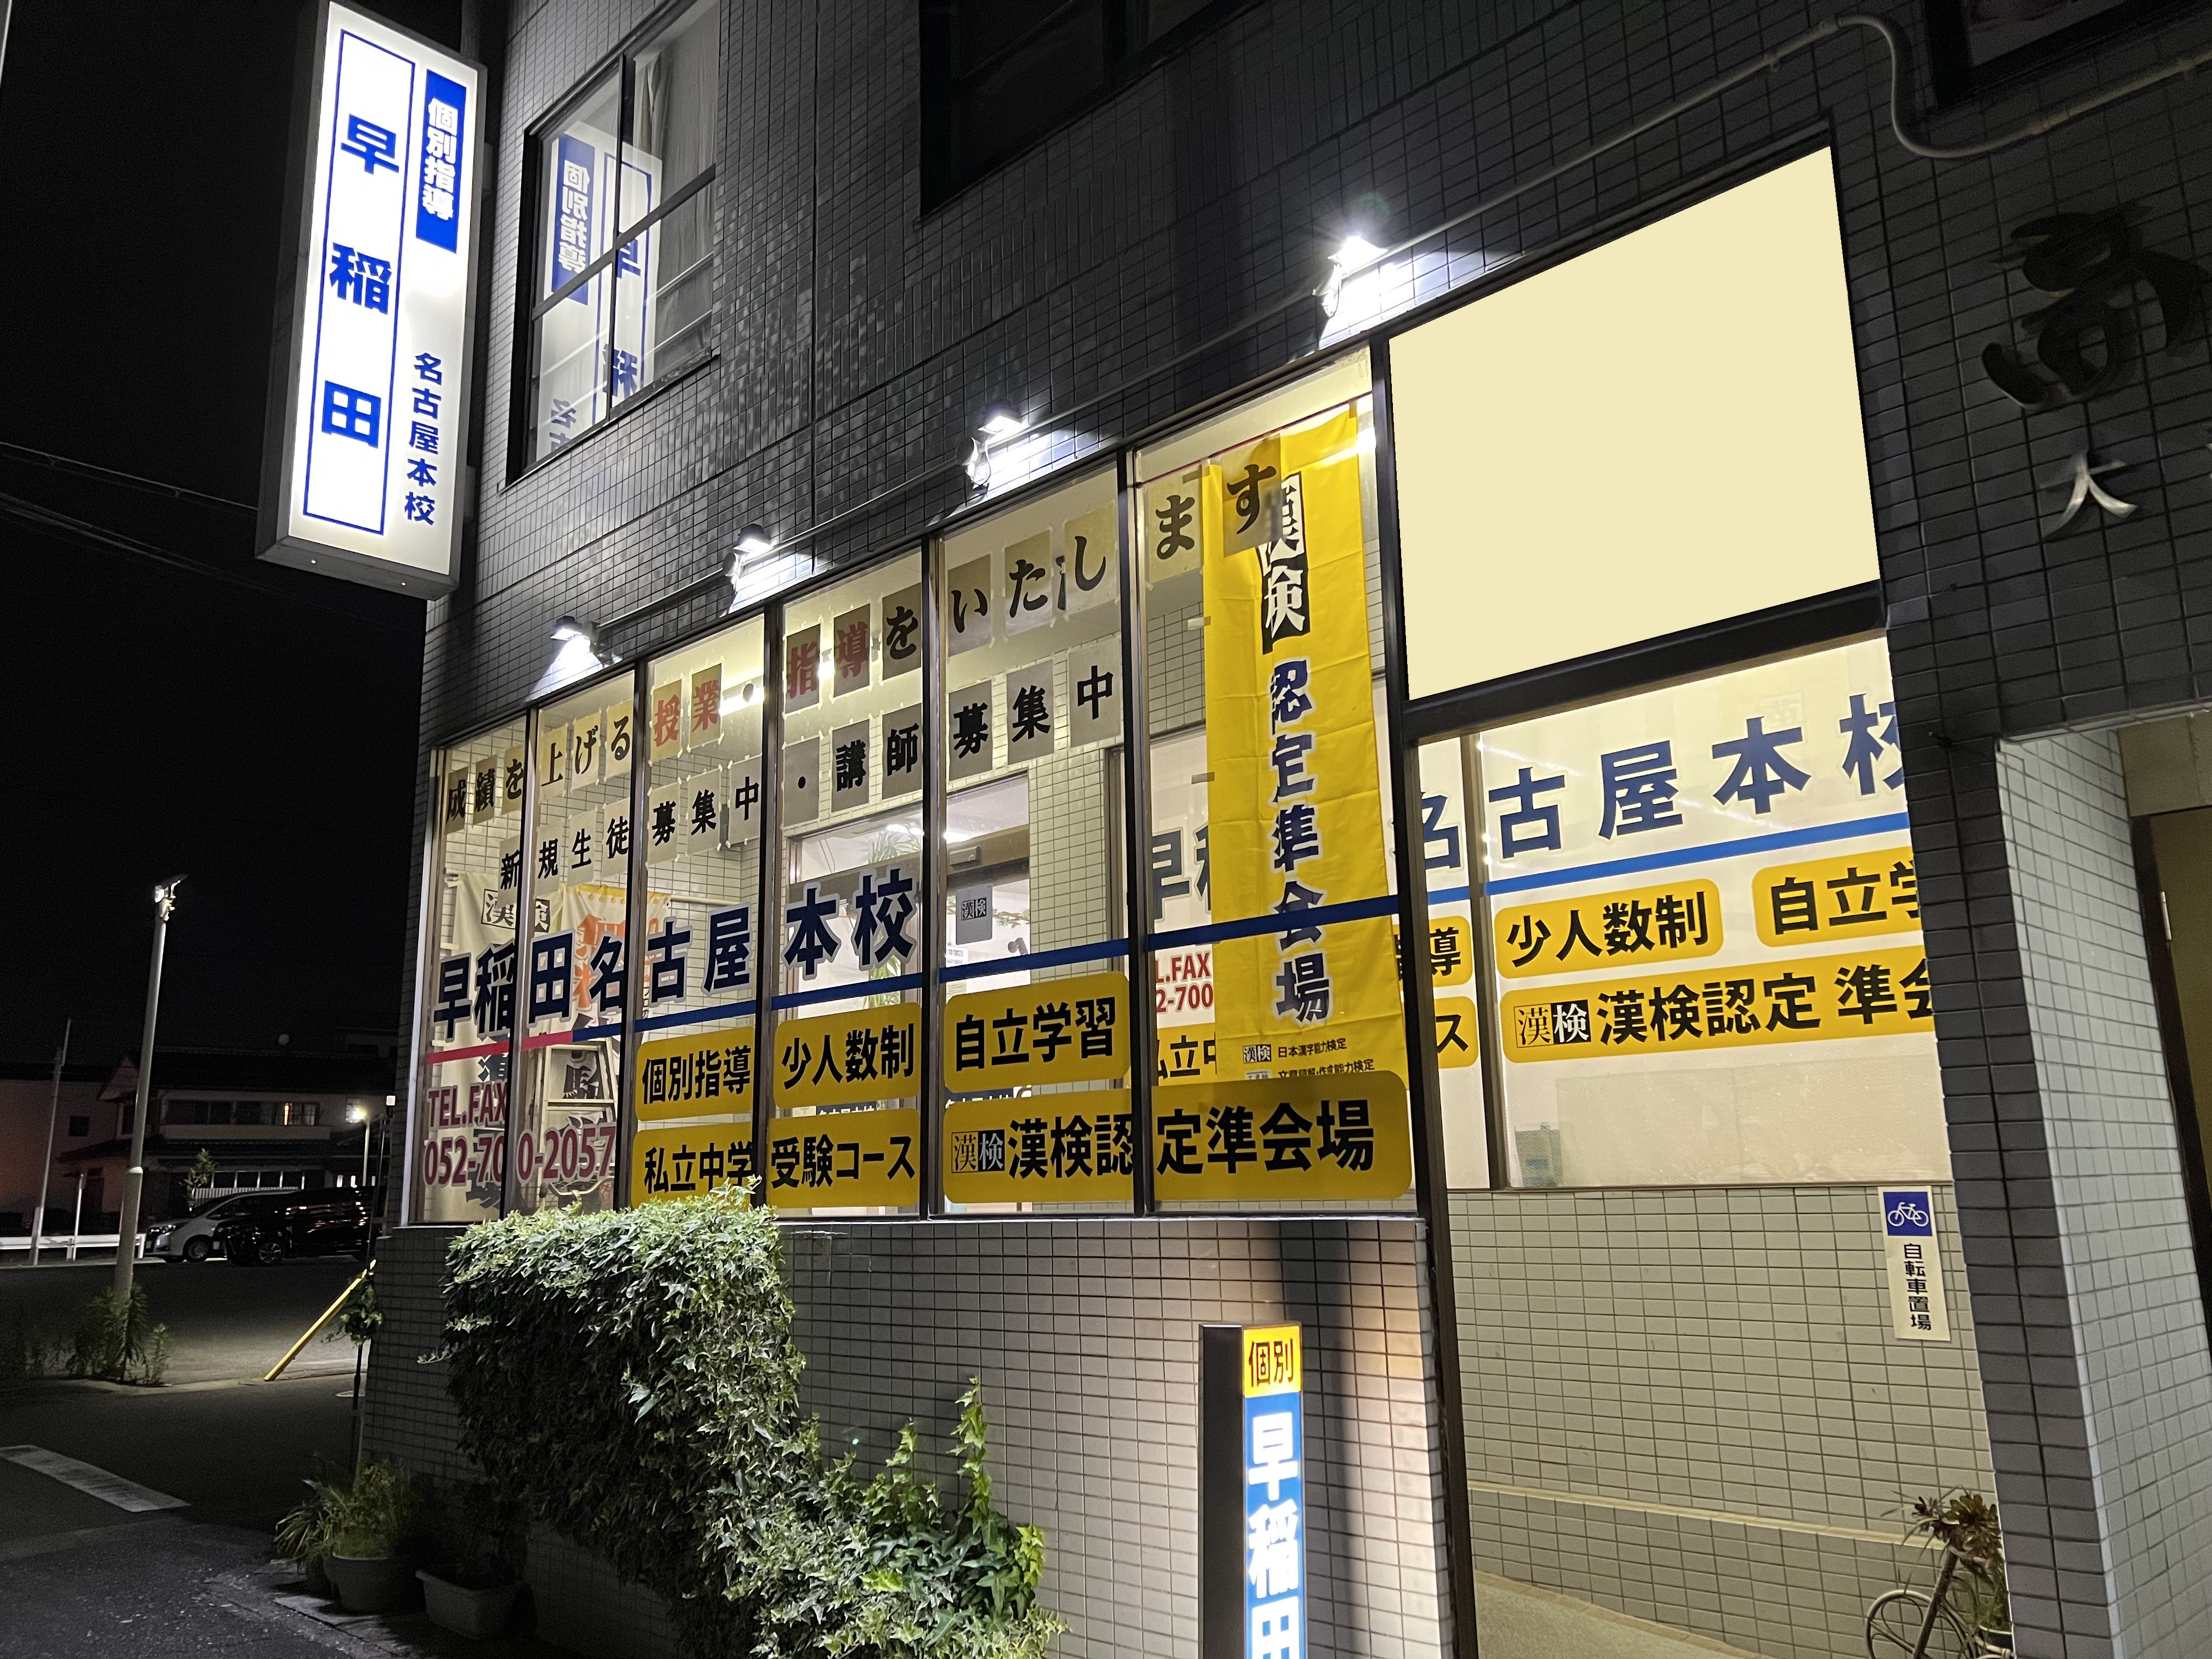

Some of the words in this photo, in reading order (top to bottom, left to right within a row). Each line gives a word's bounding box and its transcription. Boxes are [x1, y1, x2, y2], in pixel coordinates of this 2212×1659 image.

[421, 97, 458, 221] 個別指導
[321, 113, 399, 448] 早稲田
[404, 352, 442, 526] 名古屋本校
[961, 897, 987, 921] 漢検
[1505, 890, 1709, 968] 少人数制
[781, 1022, 916, 1090] 少人数制
[955, 996, 1116, 1072] 自立学習
[1243, 1044, 1272, 1064] 漢検
[1514, 1001, 1592, 1048] 漢検
[428, 1081, 507, 1128] TEL.FAX
[642, 1045, 752, 1105] 個別指導
[951, 1130, 1005, 1173] 漢検
[1008, 1099, 1375, 1180] 漢検認定準会場
[1903, 1243, 1932, 1331] 自転車置場
[1248, 1338, 1294, 1388] 個別
[1248, 1412, 1299, 1659] 早稲田
